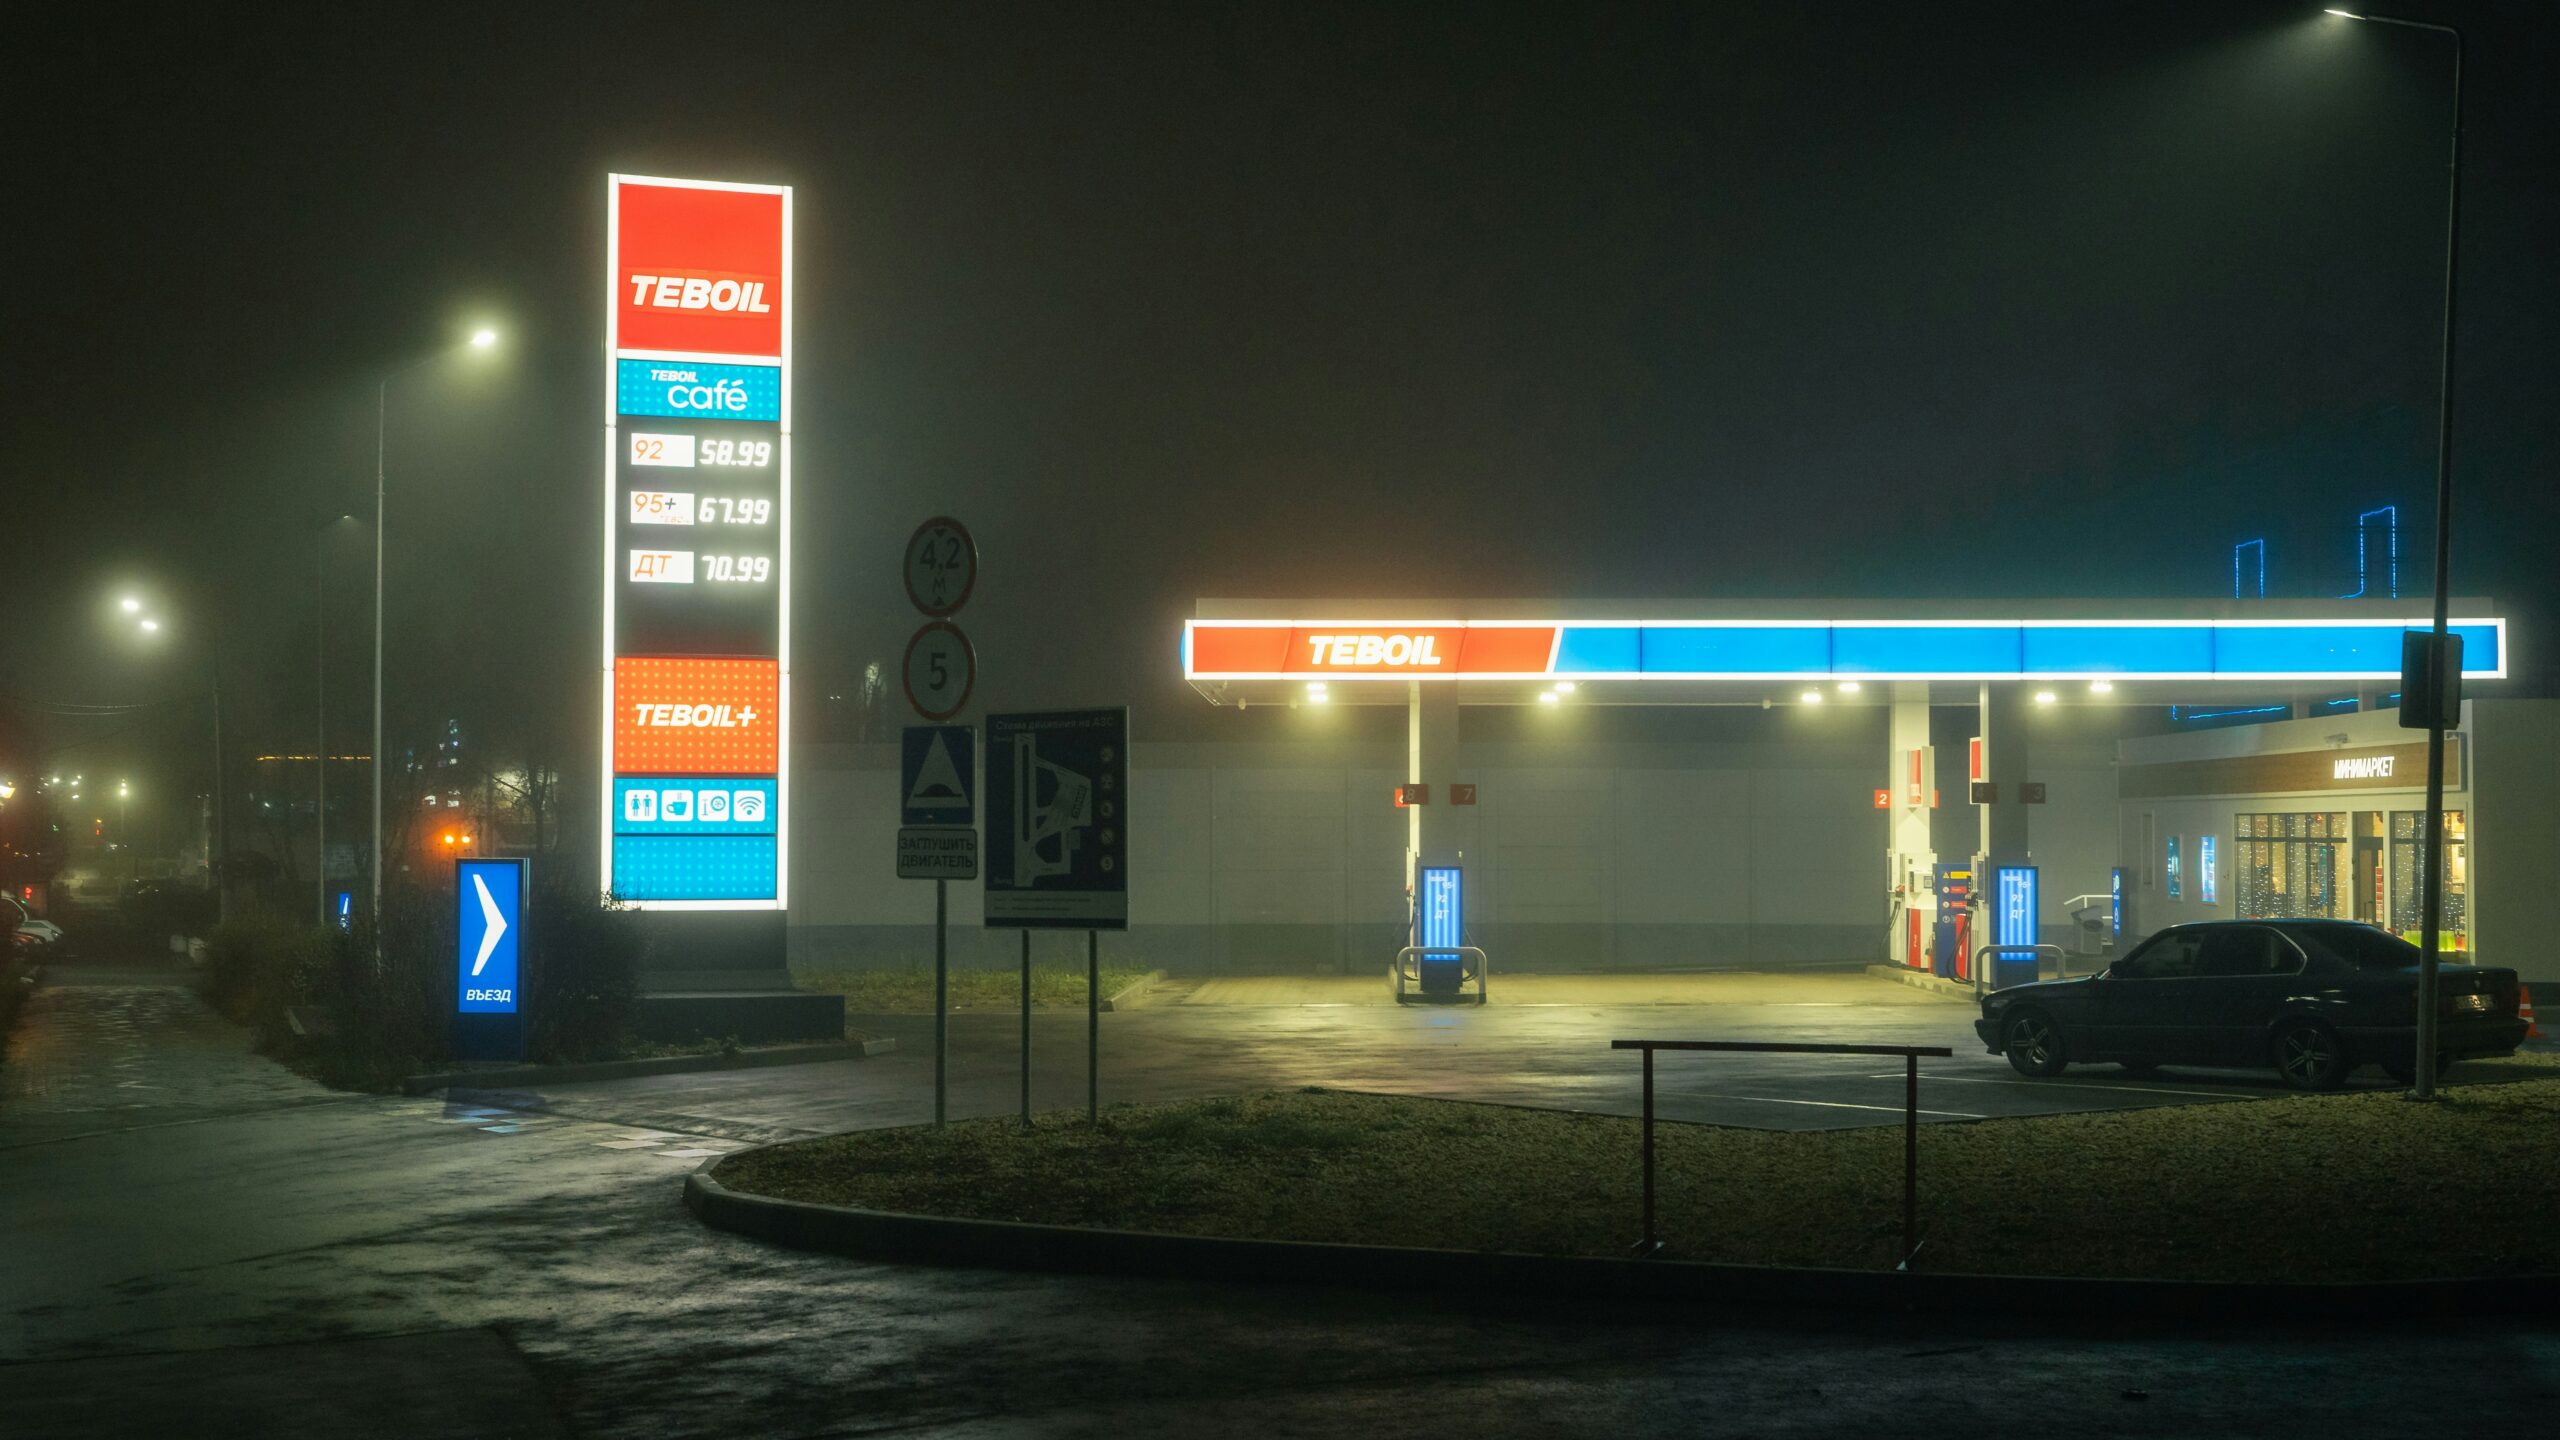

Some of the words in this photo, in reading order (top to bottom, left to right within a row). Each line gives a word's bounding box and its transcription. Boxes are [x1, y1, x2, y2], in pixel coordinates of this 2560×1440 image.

[631, 274, 771, 313] TEBOIL
[650, 369, 698, 383] TEBOIL
[667, 379, 748, 411] café
[635, 439, 663, 459] 92
[700, 439, 771, 467] 58.99
[634, 493, 676, 513] 95+
[699, 497, 771, 525] 67.99
[635, 554, 672, 578] ДТ
[702, 555, 770, 582] 70.99
[1308, 634, 1441, 665] TEBOIL
[929, 652, 947, 691] 5
[1092, 717, 1114, 727] АЗС
[2334, 755, 2395, 780] МИНИМАРКЕТ
[1407, 788, 1416, 801] 8
[1463, 788, 1473, 801] 7
[1879, 794, 1888, 804] 2
[2033, 786, 2043, 799] 3
[900, 837, 974, 851] ЗАГЛУШИТЬ
[900, 854, 974, 868] ДВИГАТЕЛЬ
[466, 989, 511, 1003] ВЪЕЗД
